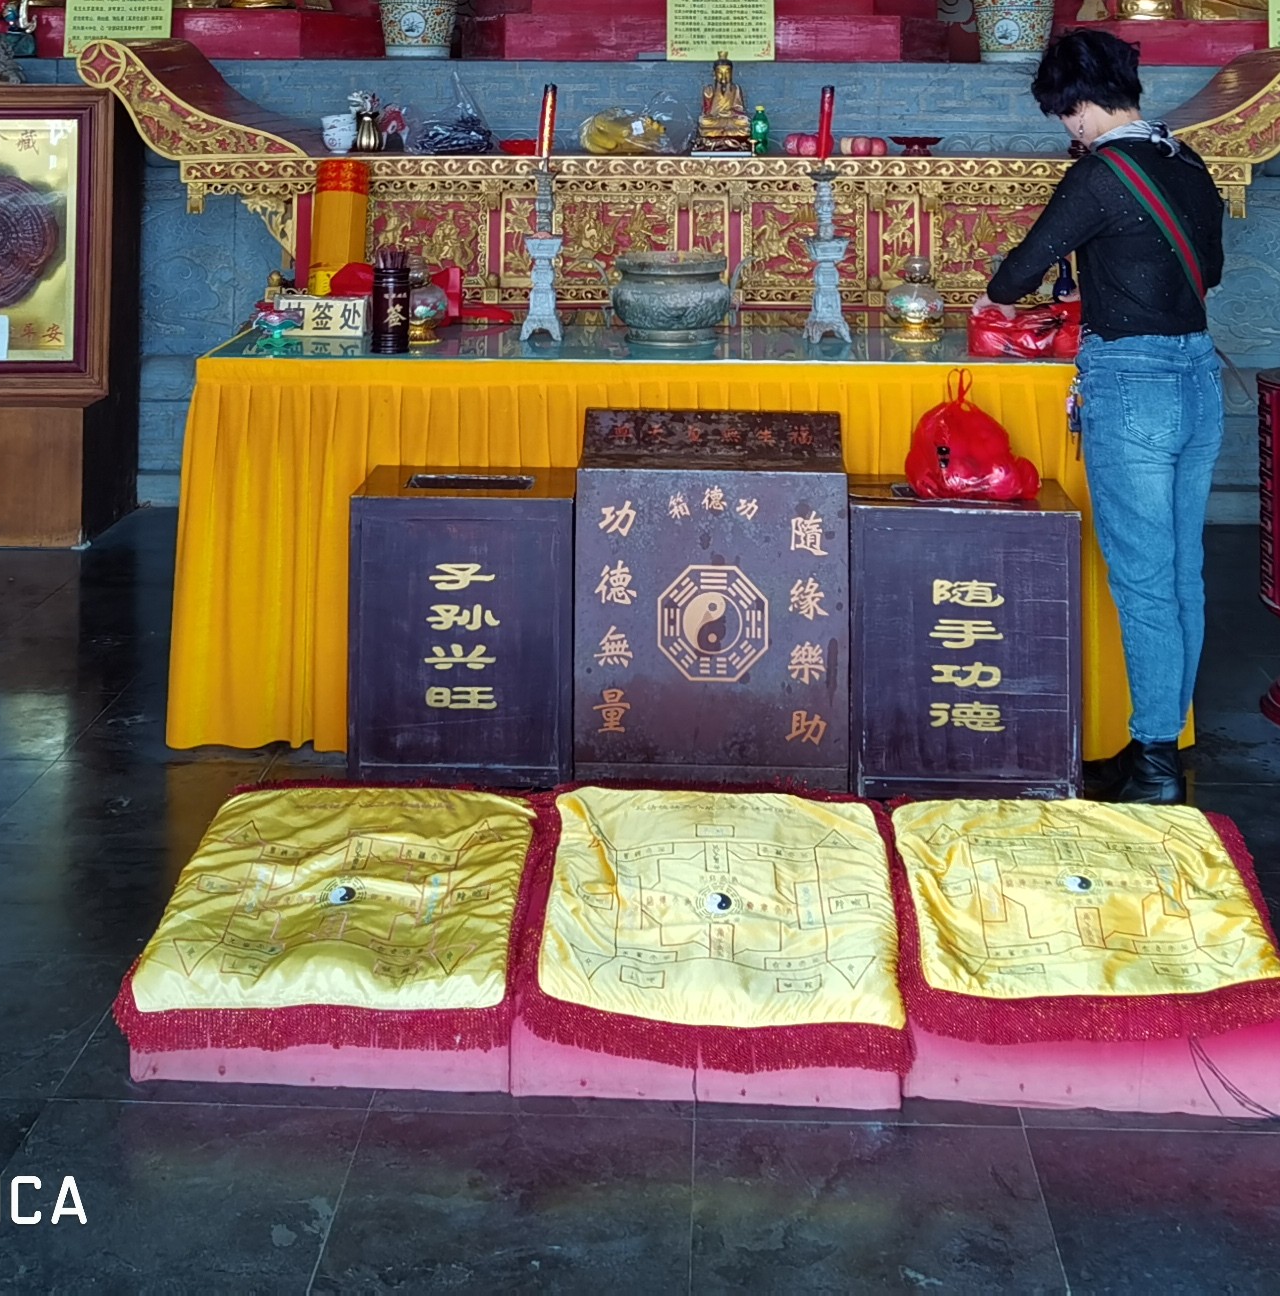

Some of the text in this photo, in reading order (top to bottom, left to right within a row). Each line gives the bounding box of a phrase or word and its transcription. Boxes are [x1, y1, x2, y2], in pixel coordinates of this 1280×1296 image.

[669, 485, 759, 521] 功德箱
[424, 563, 500, 709] 子孙兴旺
[592, 500, 638, 734] 功德無量
[785, 511, 829, 746] 隨緣樂助
[928, 579, 1006, 732] 随手功德
